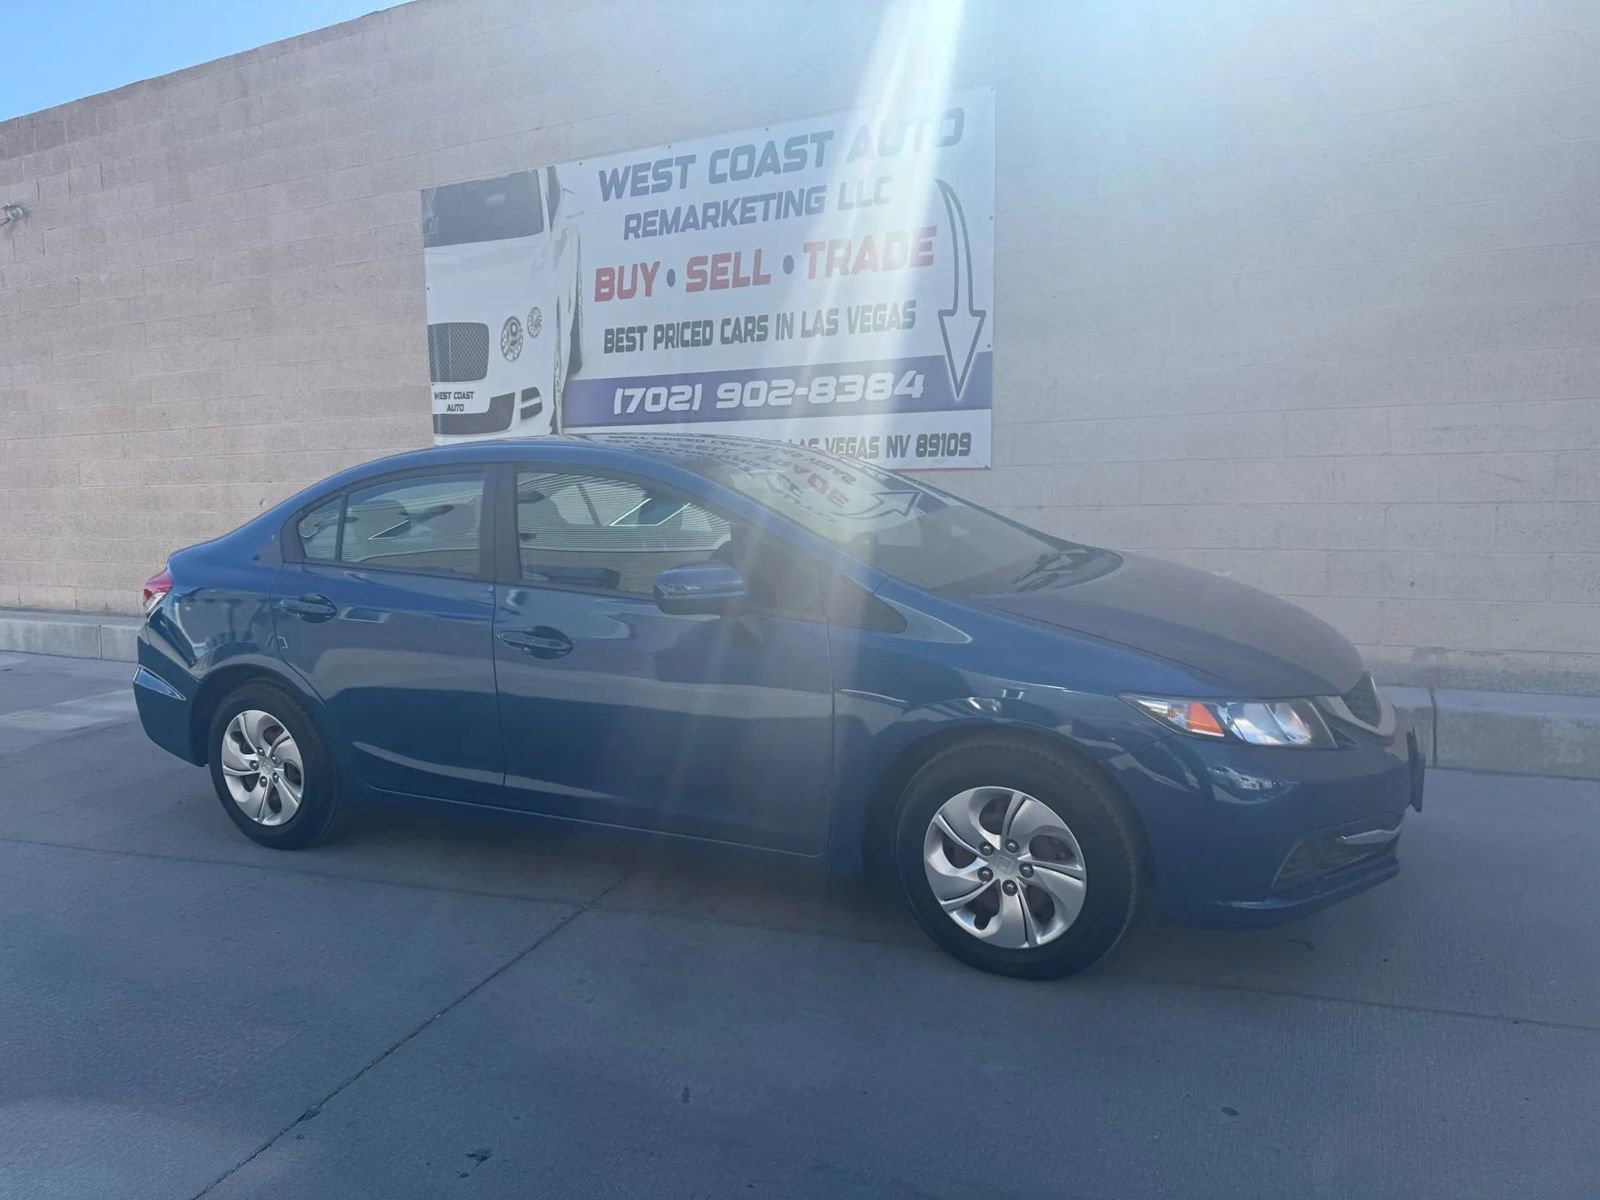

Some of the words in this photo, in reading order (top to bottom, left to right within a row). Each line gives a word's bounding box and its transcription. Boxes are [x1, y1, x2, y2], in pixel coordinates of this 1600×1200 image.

[598, 154, 696, 202] WEST
[708, 130, 834, 185] COAST
[846, 107, 965, 164] AUTO
[623, 185, 827, 241] REMARKETING
[838, 176, 894, 211] LLC
[594, 260, 661, 302] BUY
[685, 248, 772, 293] SELL
[803, 225, 938, 280] TRADE
[603, 325, 648, 354] BEST
[652, 319, 714, 351] PRICED
[720, 314, 769, 345] CARS
[775, 311, 795, 341] IN
[800, 307, 839, 338] LAS
[847, 300, 917, 334] VEGAS
[434, 391, 452, 400] WEST
[453, 391, 474, 399] COAST
[446, 403, 464, 412] AUTO
[613, 383, 702, 415] (702)
[715, 370, 925, 409] 902-8384
[824, 436, 880, 459] VEGAS
[886, 434, 911, 458] NV
[915, 432, 972, 458] 89109
